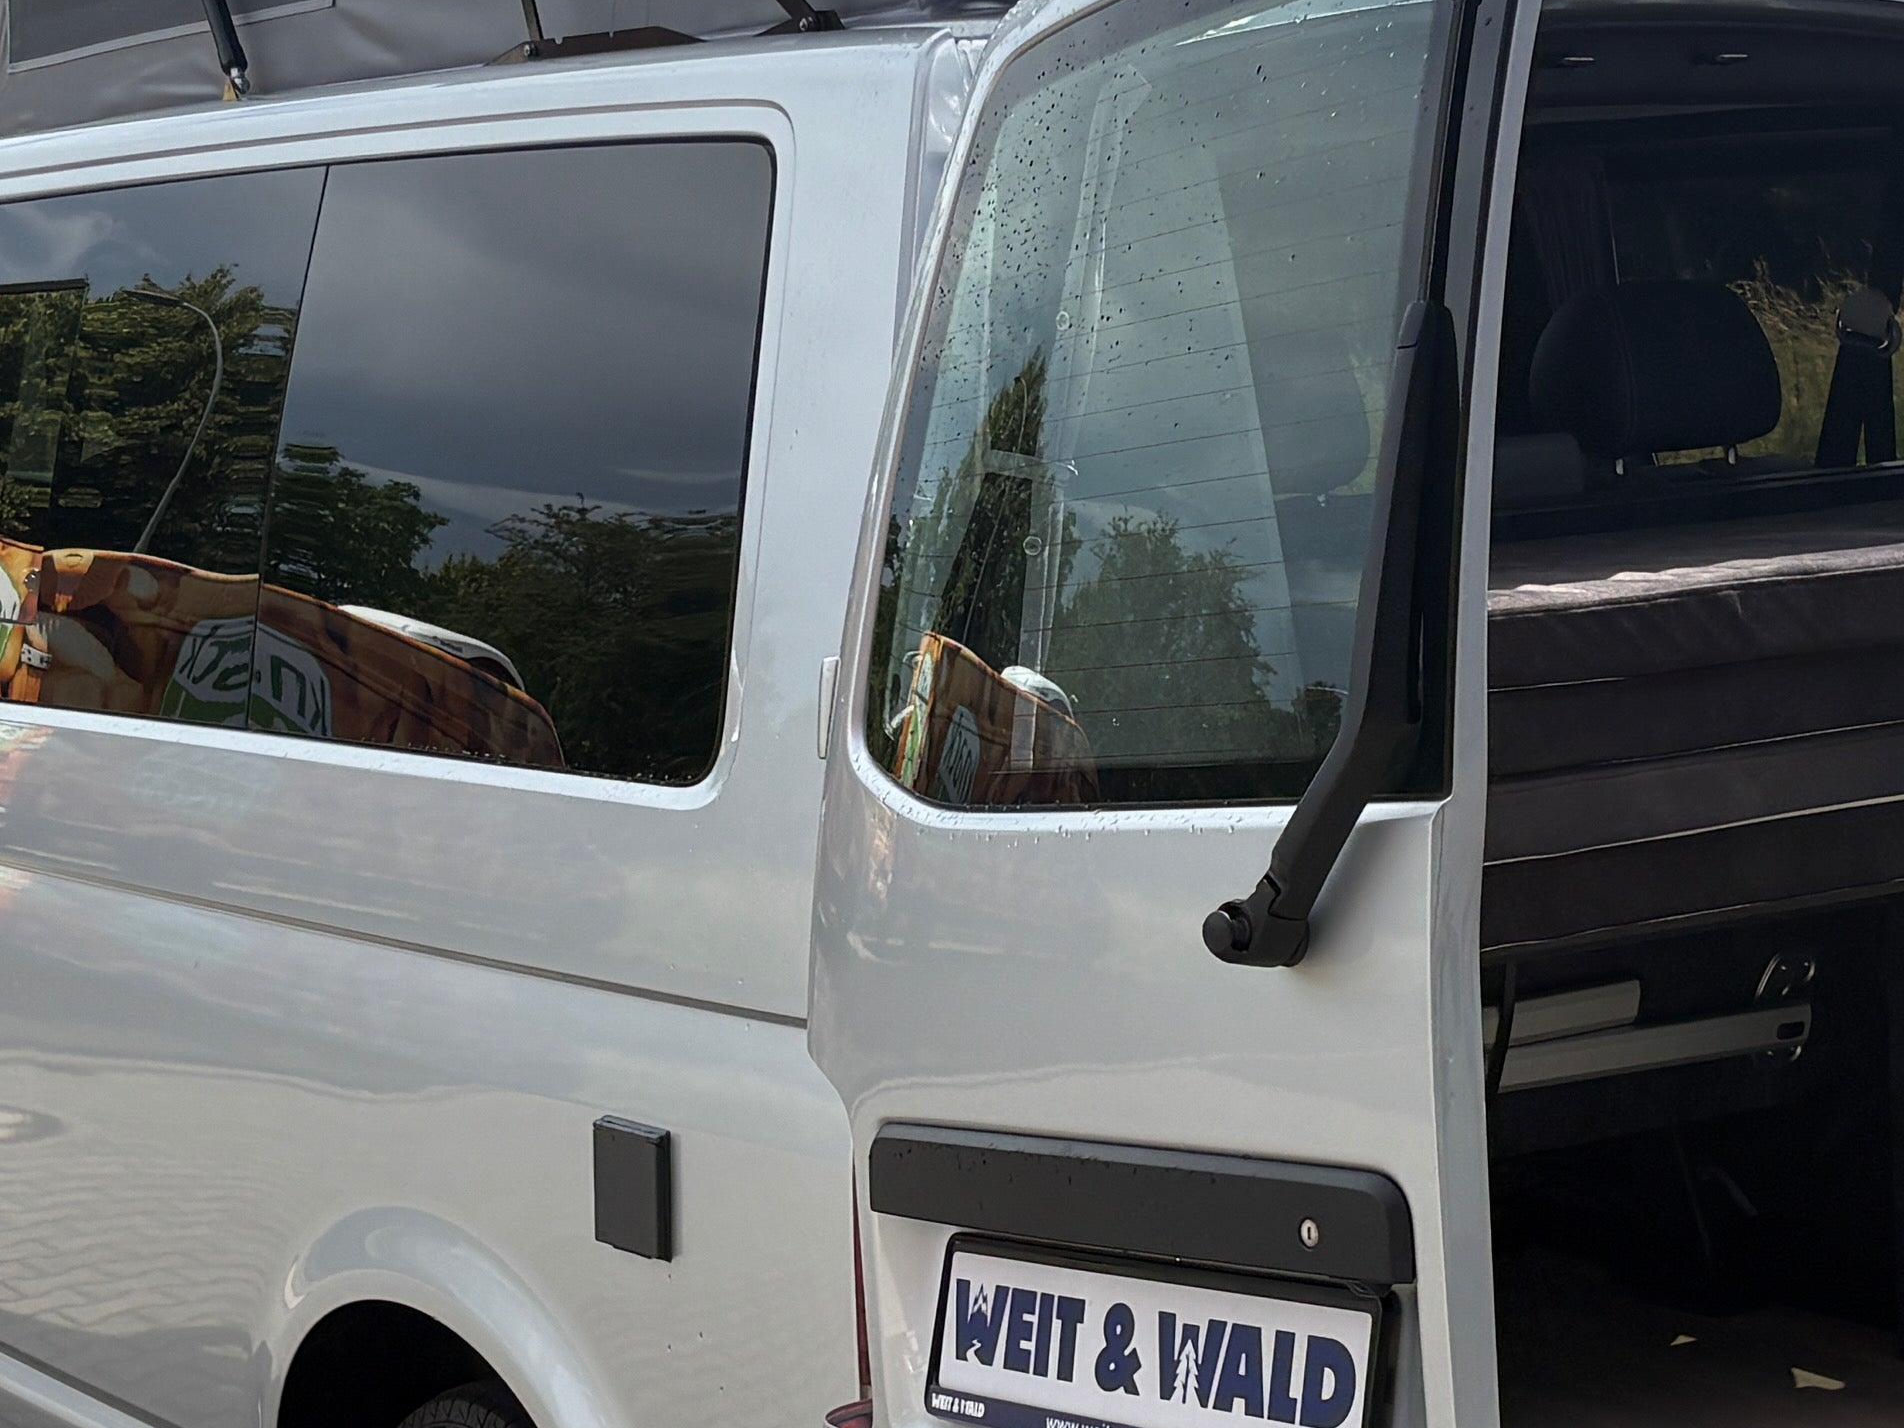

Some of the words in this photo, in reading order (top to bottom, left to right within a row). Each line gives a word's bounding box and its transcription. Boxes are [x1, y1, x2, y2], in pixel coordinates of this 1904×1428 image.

[955, 1277, 1087, 1383] WEIT
[1094, 1302, 1143, 1397] &
[931, 1393, 953, 1411] WEIT
